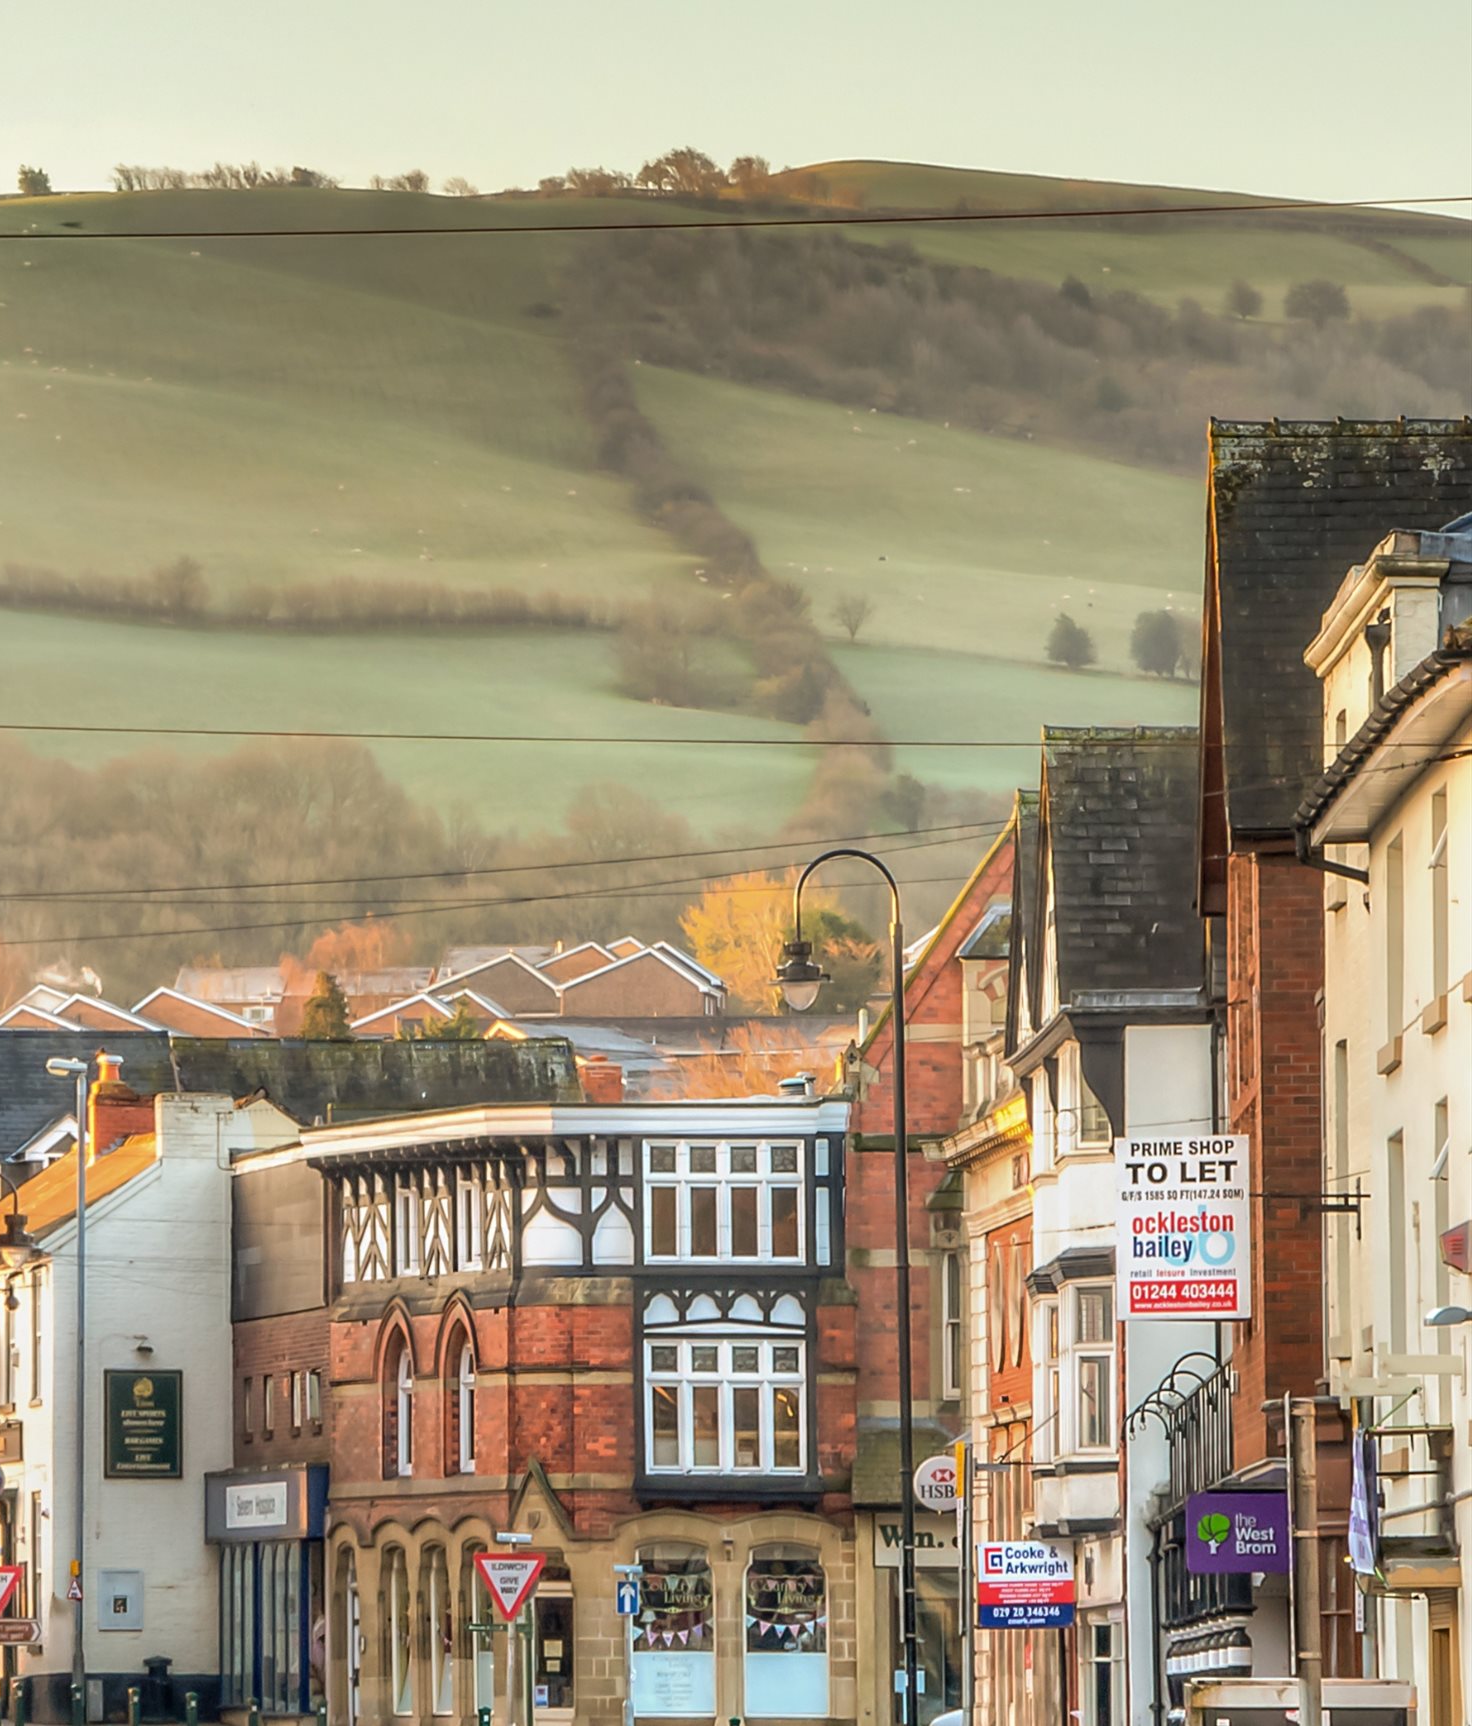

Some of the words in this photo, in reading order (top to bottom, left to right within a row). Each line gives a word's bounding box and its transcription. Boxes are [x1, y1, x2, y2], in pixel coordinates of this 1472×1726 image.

[1130, 1141, 1183, 1157] PRIME
[1189, 1140, 1235, 1155] SHOP
[1125, 1162, 1168, 1184] TO
[1180, 1160, 1238, 1183] LET
[1145, 1191, 1165, 1201] 1585
[1167, 1190, 1178, 1200] SQ
[1132, 1211, 1234, 1234] ockleston
[1133, 1235, 1193, 1263] bailey
[1130, 1270, 1152, 1278] retail
[1156, 1269, 1185, 1277] leisure
[1190, 1268, 1236, 1276] investment
[1132, 1284, 1177, 1299] 01244
[1181, 1283, 1235, 1298] 403444
[920, 1485, 957, 1499] HSB
[1235, 1512, 1257, 1528] the
[1235, 1527, 1274, 1541] West
[1005, 1546, 1045, 1560] Cooke
[1049, 1545, 1058, 1559] &
[1236, 1541, 1277, 1555] Brom
[492, 1563, 528, 1571] ILDIWCH
[1005, 1560, 1068, 1576] Arkwright
[500, 1577, 520, 1585] GIVE
[993, 1607, 1010, 1618] 029
[1013, 1607, 1025, 1617] 20
